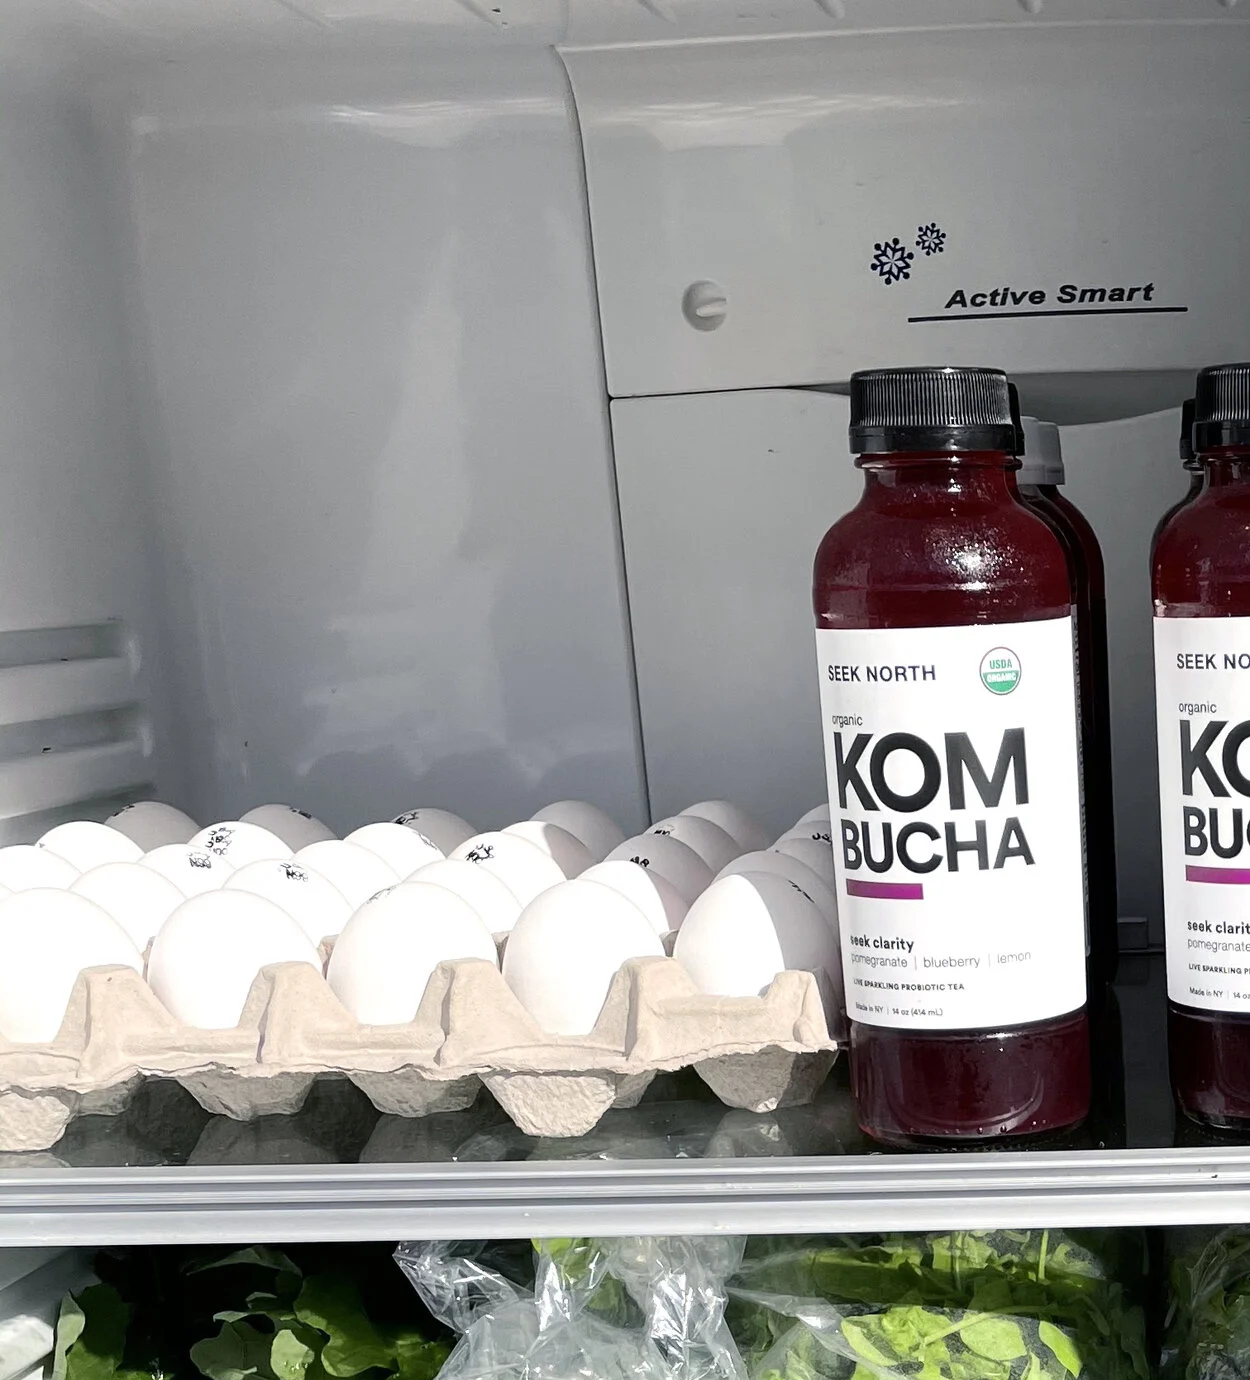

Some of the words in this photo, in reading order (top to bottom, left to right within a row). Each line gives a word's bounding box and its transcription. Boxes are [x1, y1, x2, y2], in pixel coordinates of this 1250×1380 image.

[945, 287, 1045, 309] Active
[1057, 283, 1154, 303] Smart
[990, 659, 1012, 669] USDA
[1177, 653, 1217, 670] SEEK
[828, 665, 861, 681] SEEK
[867, 665, 936, 681] NORTH
[1179, 702, 1217, 715] organic
[832, 713, 863, 728] organic
[833, 727, 1029, 814] KOM
[841, 816, 1036, 874] BUCHA
[1188, 920, 1212, 933] seek
[850, 934, 870, 948] seek
[873, 936, 914, 953] clarity
[851, 953, 908, 968] pomegranate
[924, 956, 980, 968] blueberry
[997, 952, 1031, 964] lemon
